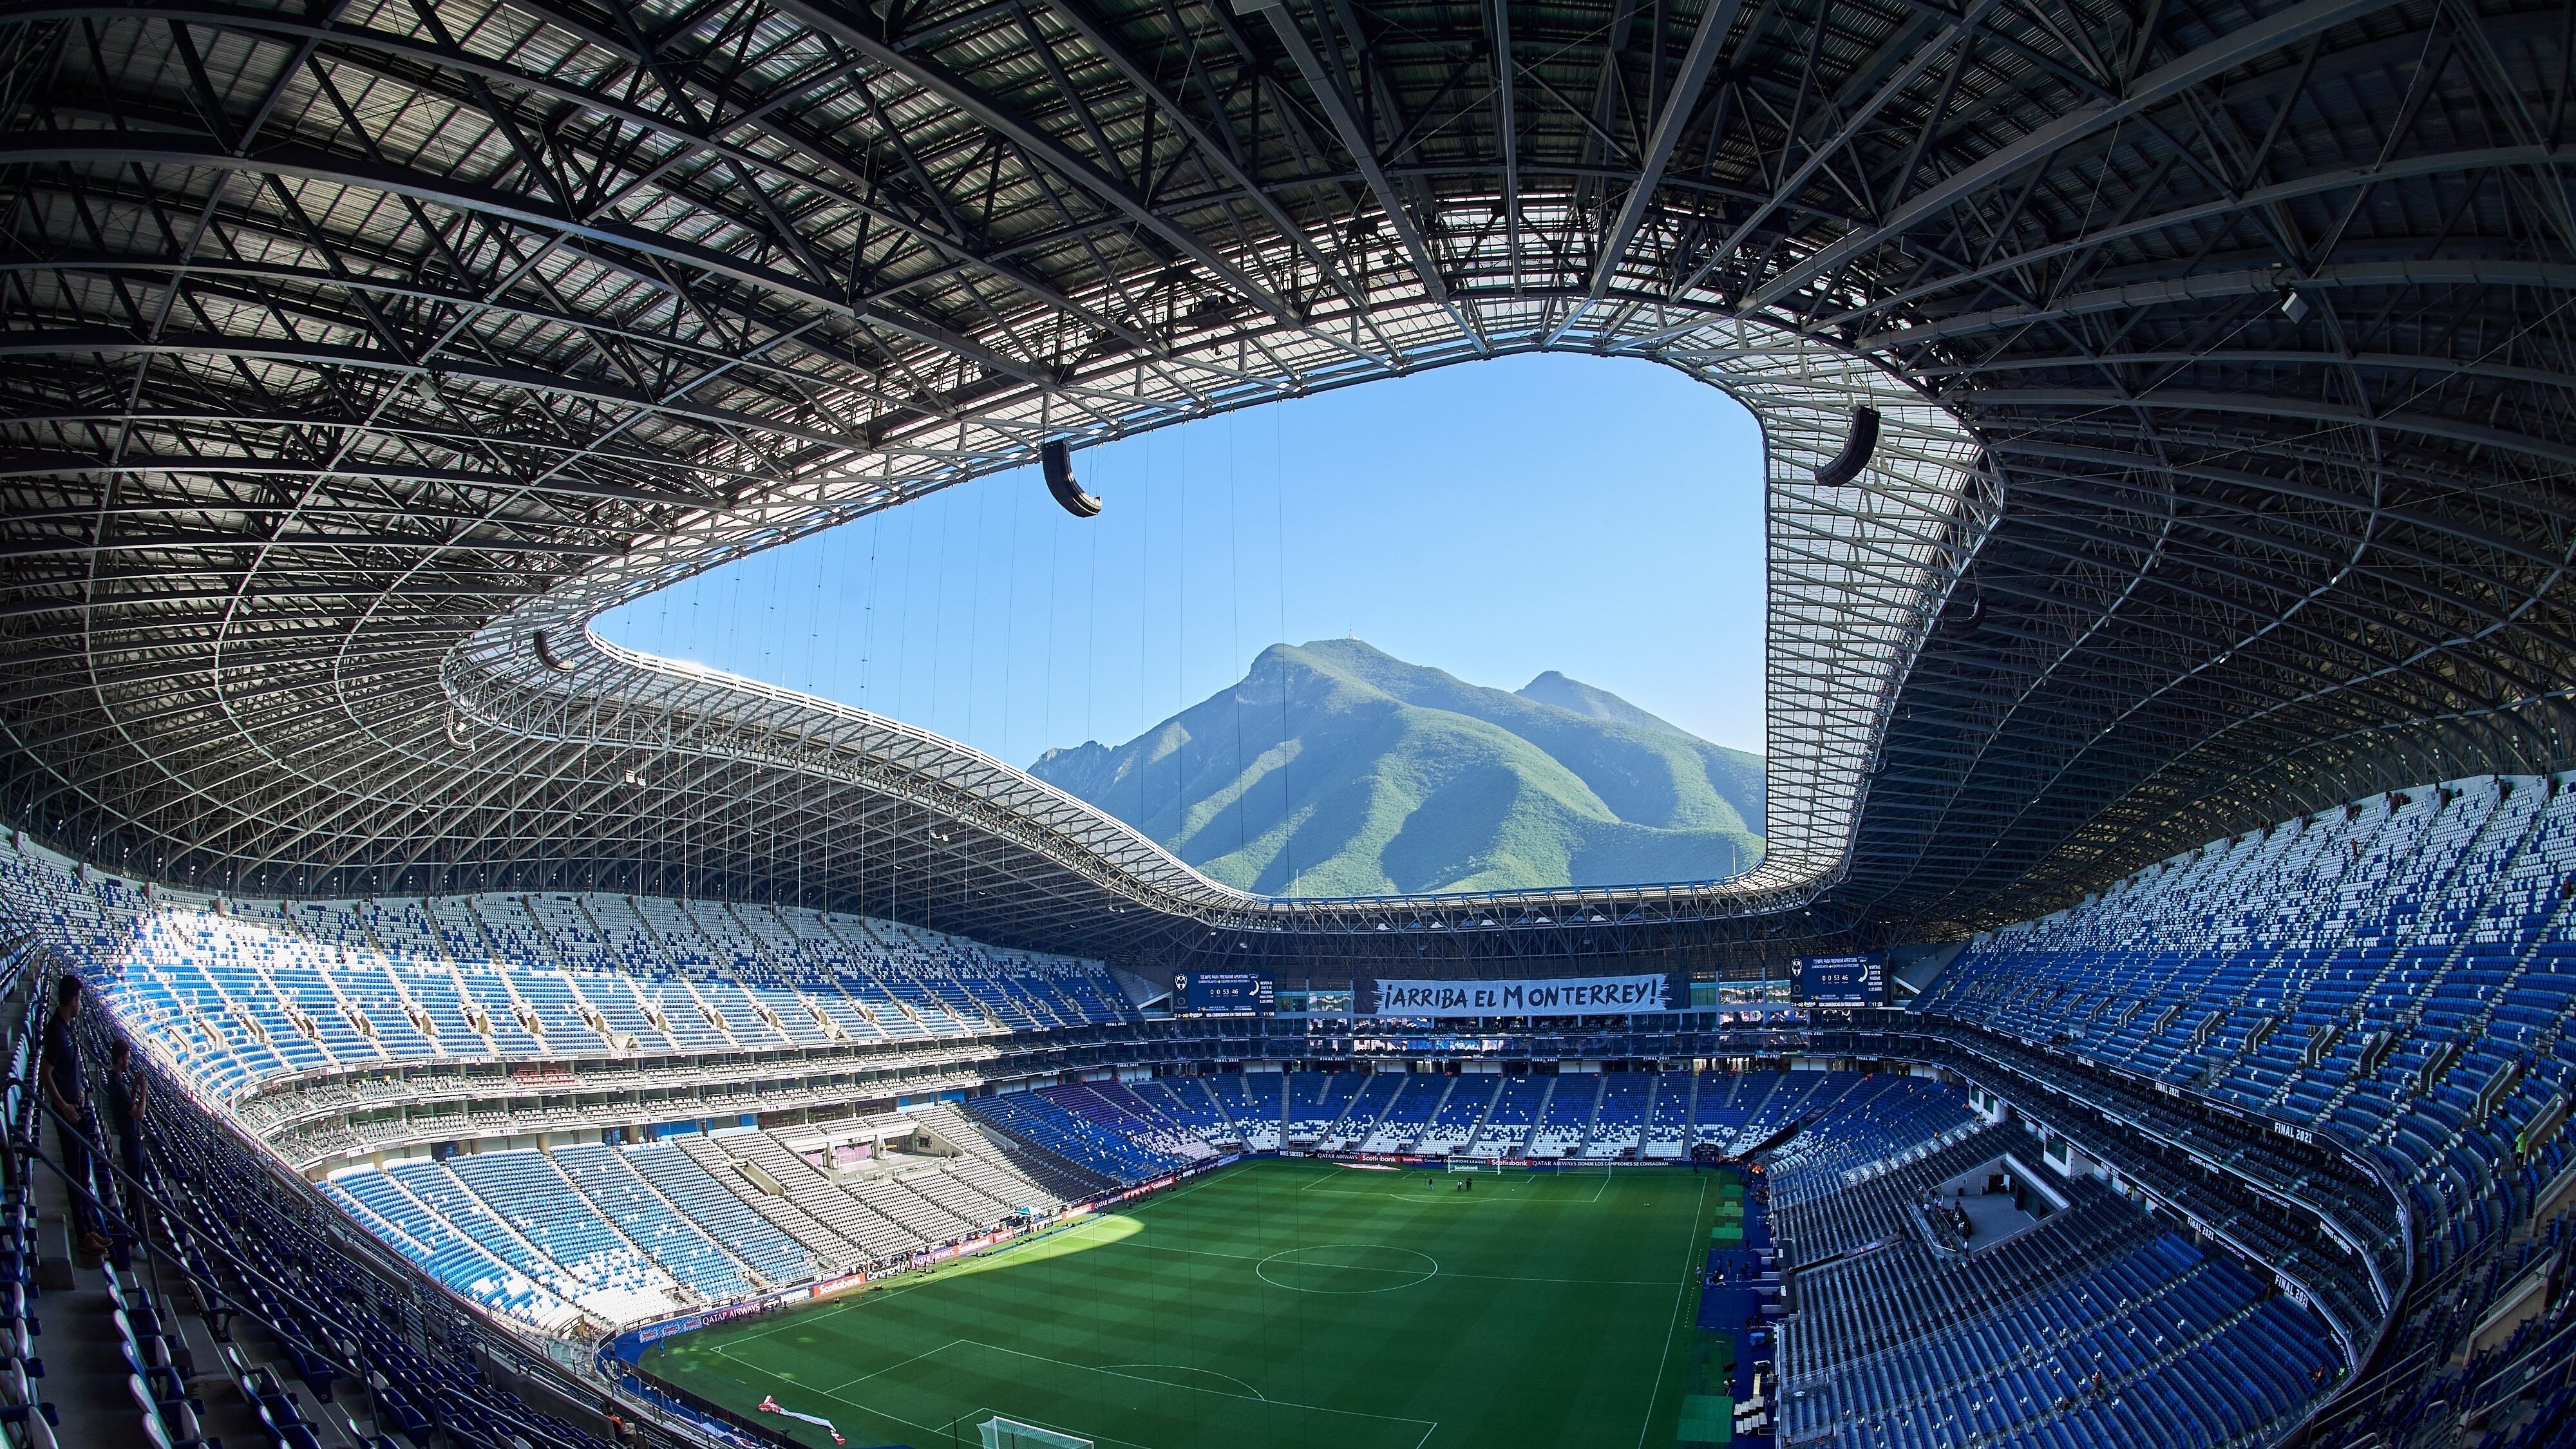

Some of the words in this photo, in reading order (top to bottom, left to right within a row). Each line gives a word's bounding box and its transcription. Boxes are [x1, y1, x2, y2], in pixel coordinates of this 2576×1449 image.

[2490, 783, 2495, 791] 14
[2536, 777, 2542, 787] 15
[1385, 984, 1468, 1009] ¡ARRIBA
[1475, 990, 1497, 1007] EL
[1504, 978, 1658, 1010] MONTERREY!
[2155, 1082, 2168, 1094] FINAL
[2169, 1086, 2179, 1097] 2021
[2275, 1122, 2294, 1138] FINAL
[2296, 1129, 2312, 1144] 2021
[2101, 1161, 2110, 1173] FINAL
[1151, 1177, 1173, 1189] Scotiabank
[1095, 1199, 1108, 1209] QATAR
[2187, 1217, 2201, 1232] FINAL
[2202, 1226, 2214, 1241] 2021
[2337, 1237, 2351, 1255] AMÉRICA
[912, 1256, 931, 1267] QATAR
[932, 1248, 954, 1261] AIRWAYS
[819, 1276, 861, 1295] Scotiabank
[2275, 1274, 2294, 1296] FINAL
[2295, 1288, 2308, 1308] 2021
[729, 1303, 761, 1319] AIRWAYS
